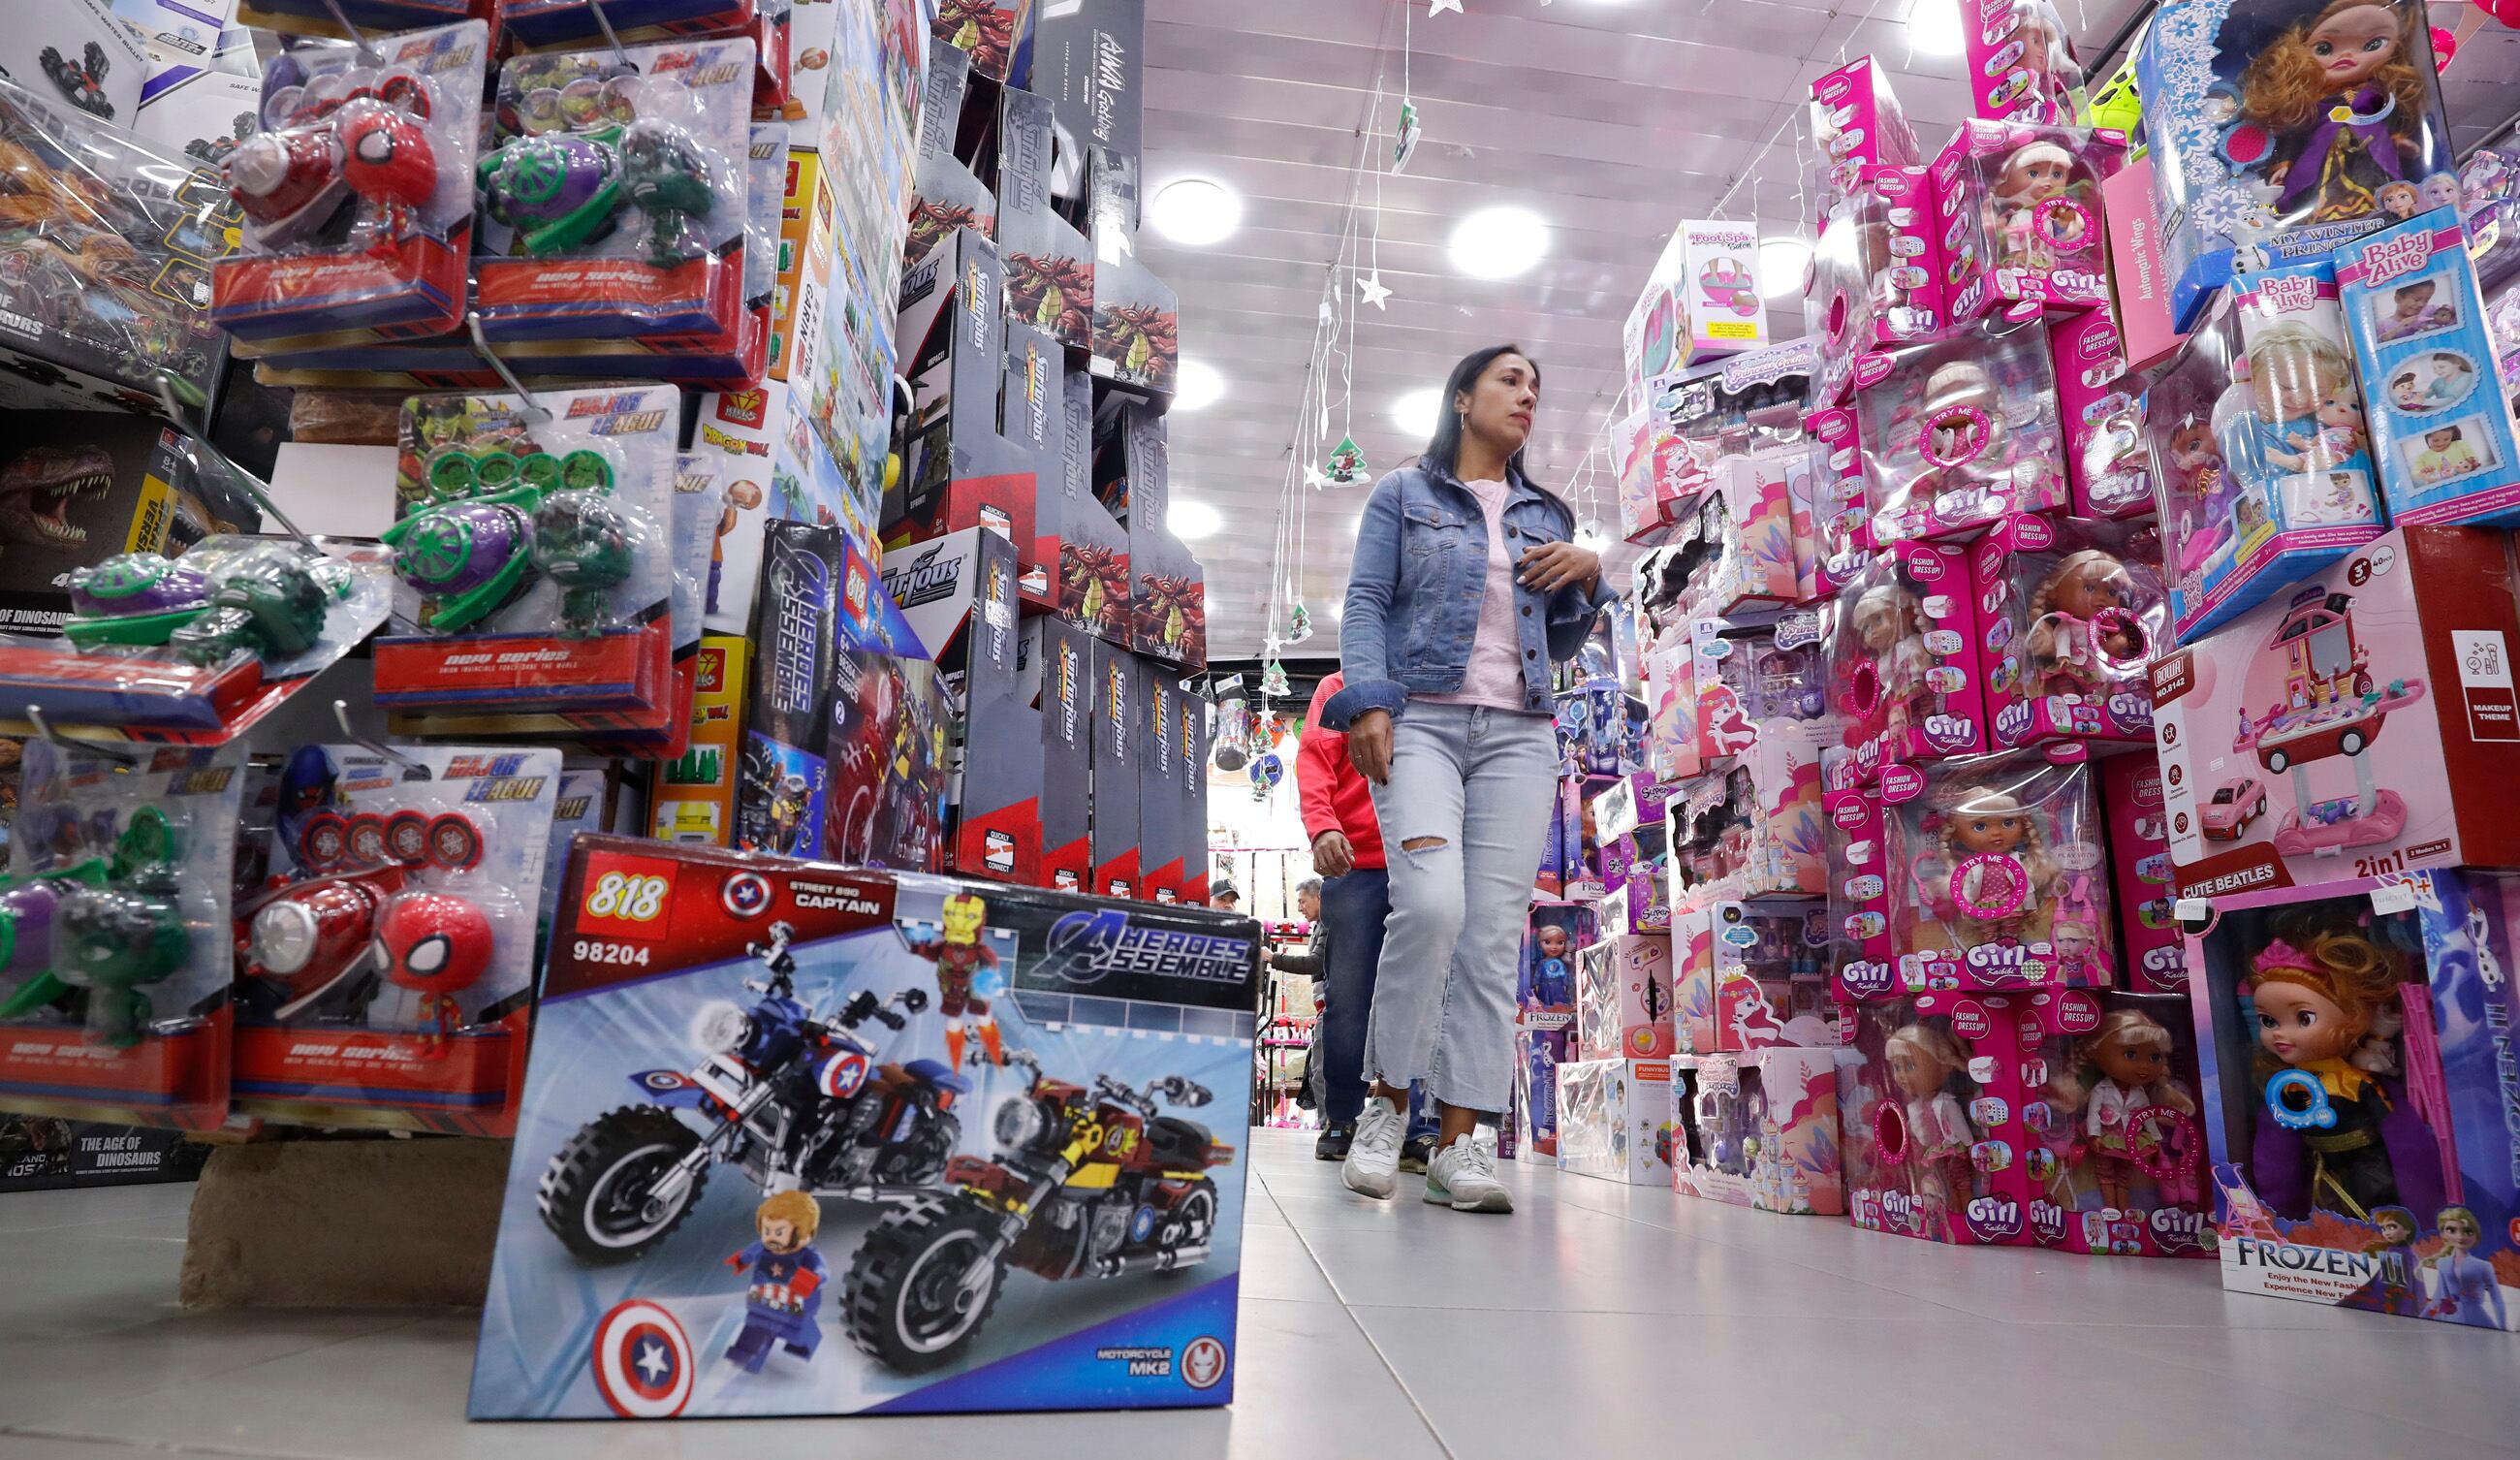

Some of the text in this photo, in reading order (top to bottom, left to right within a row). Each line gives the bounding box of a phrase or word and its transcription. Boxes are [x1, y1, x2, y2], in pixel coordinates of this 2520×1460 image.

[122, 41, 144, 63] BULLET
[2045, 198, 2078, 209] TRY ME
[1695, 233, 1750, 244] Foot Spa
[2131, 217, 2145, 249] Wings
[2271, 218, 2386, 248] MY WINTER
[2363, 230, 2433, 265] Baby
[2371, 253, 2424, 284] Alive
[2135, 251, 2153, 302] Automatic
[2262, 275, 2315, 295] Baby
[2083, 330, 2110, 344] FASHION
[1858, 358, 1883, 372] FASHION
[1935, 405, 1973, 422] TRY ME
[1820, 419, 1842, 430] FASHION
[985, 504, 1007, 519] QUICKLY
[2018, 523, 2041, 532] FASHION
[2020, 531, 2038, 541] DRESS
[1911, 557, 1935, 566] FASHION
[1913, 565, 1931, 574] DRESS
[846, 565, 866, 613] 818
[1022, 585, 1045, 597] CONNECT
[2182, 572, 2202, 596] Baby
[13, 610, 79, 626] DINOSAUR
[2097, 609, 2133, 620] TRY ME
[444, 648, 572, 666] new series
[2156, 677, 2186, 699] NO.8142
[1996, 699, 2030, 731] Girl
[2473, 704, 2512, 713] MAKEUP
[2478, 714, 2511, 722] THEME
[1924, 714, 1971, 738] Girl
[1885, 775, 1911, 785] FASHION
[1887, 783, 1907, 794] DRESS
[1838, 805, 1860, 815] FASHION
[1839, 813, 1857, 823] DRESS
[990, 830, 1010, 841] QUICKLY
[987, 862, 1010, 873] CONNECT
[1962, 854, 2003, 870] TRY ME
[2354, 849, 2405, 878] 2in1
[1057, 869, 1075, 878] QUICKLY
[790, 881, 835, 895] STREET
[1113, 879, 1128, 888] QUICKLY
[2183, 863, 2276, 900] CUTE BEATLES
[586, 871, 670, 922] 818
[795, 894, 881, 916] CAPTAIN
[572, 939, 650, 968] 98204
[1967, 944, 2026, 967] Girl
[1843, 961, 1889, 982] Girl
[1986, 967, 2016, 975] Kaibibi
[2062, 1002, 2088, 1013] FASHION
[1530, 1013, 1569, 1023] FROZEN
[1955, 1011, 1979, 1022] FASHION
[2063, 1012, 2084, 1023] DRESS
[1957, 1021, 1976, 1032] DRESS
[2135, 1107, 2176, 1121] TRY ME
[80, 1136, 142, 1152] THE AGE OF
[96, 1152, 162, 1167] DINOSAURS
[1966, 1199, 2018, 1223] Girl
[2149, 1208, 2203, 1233] Girl
[2237, 1236, 2410, 1287] FROZEN II
[2267, 1272, 2291, 1284] Enjoy
[2293, 1275, 2309, 1285] the
[2311, 1278, 2331, 1287] New
[2264, 1282, 2336, 1298] Experience New
[1097, 1348, 1173, 1360] MOTORCYCLE
[1128, 1360, 1172, 1377] MK2
